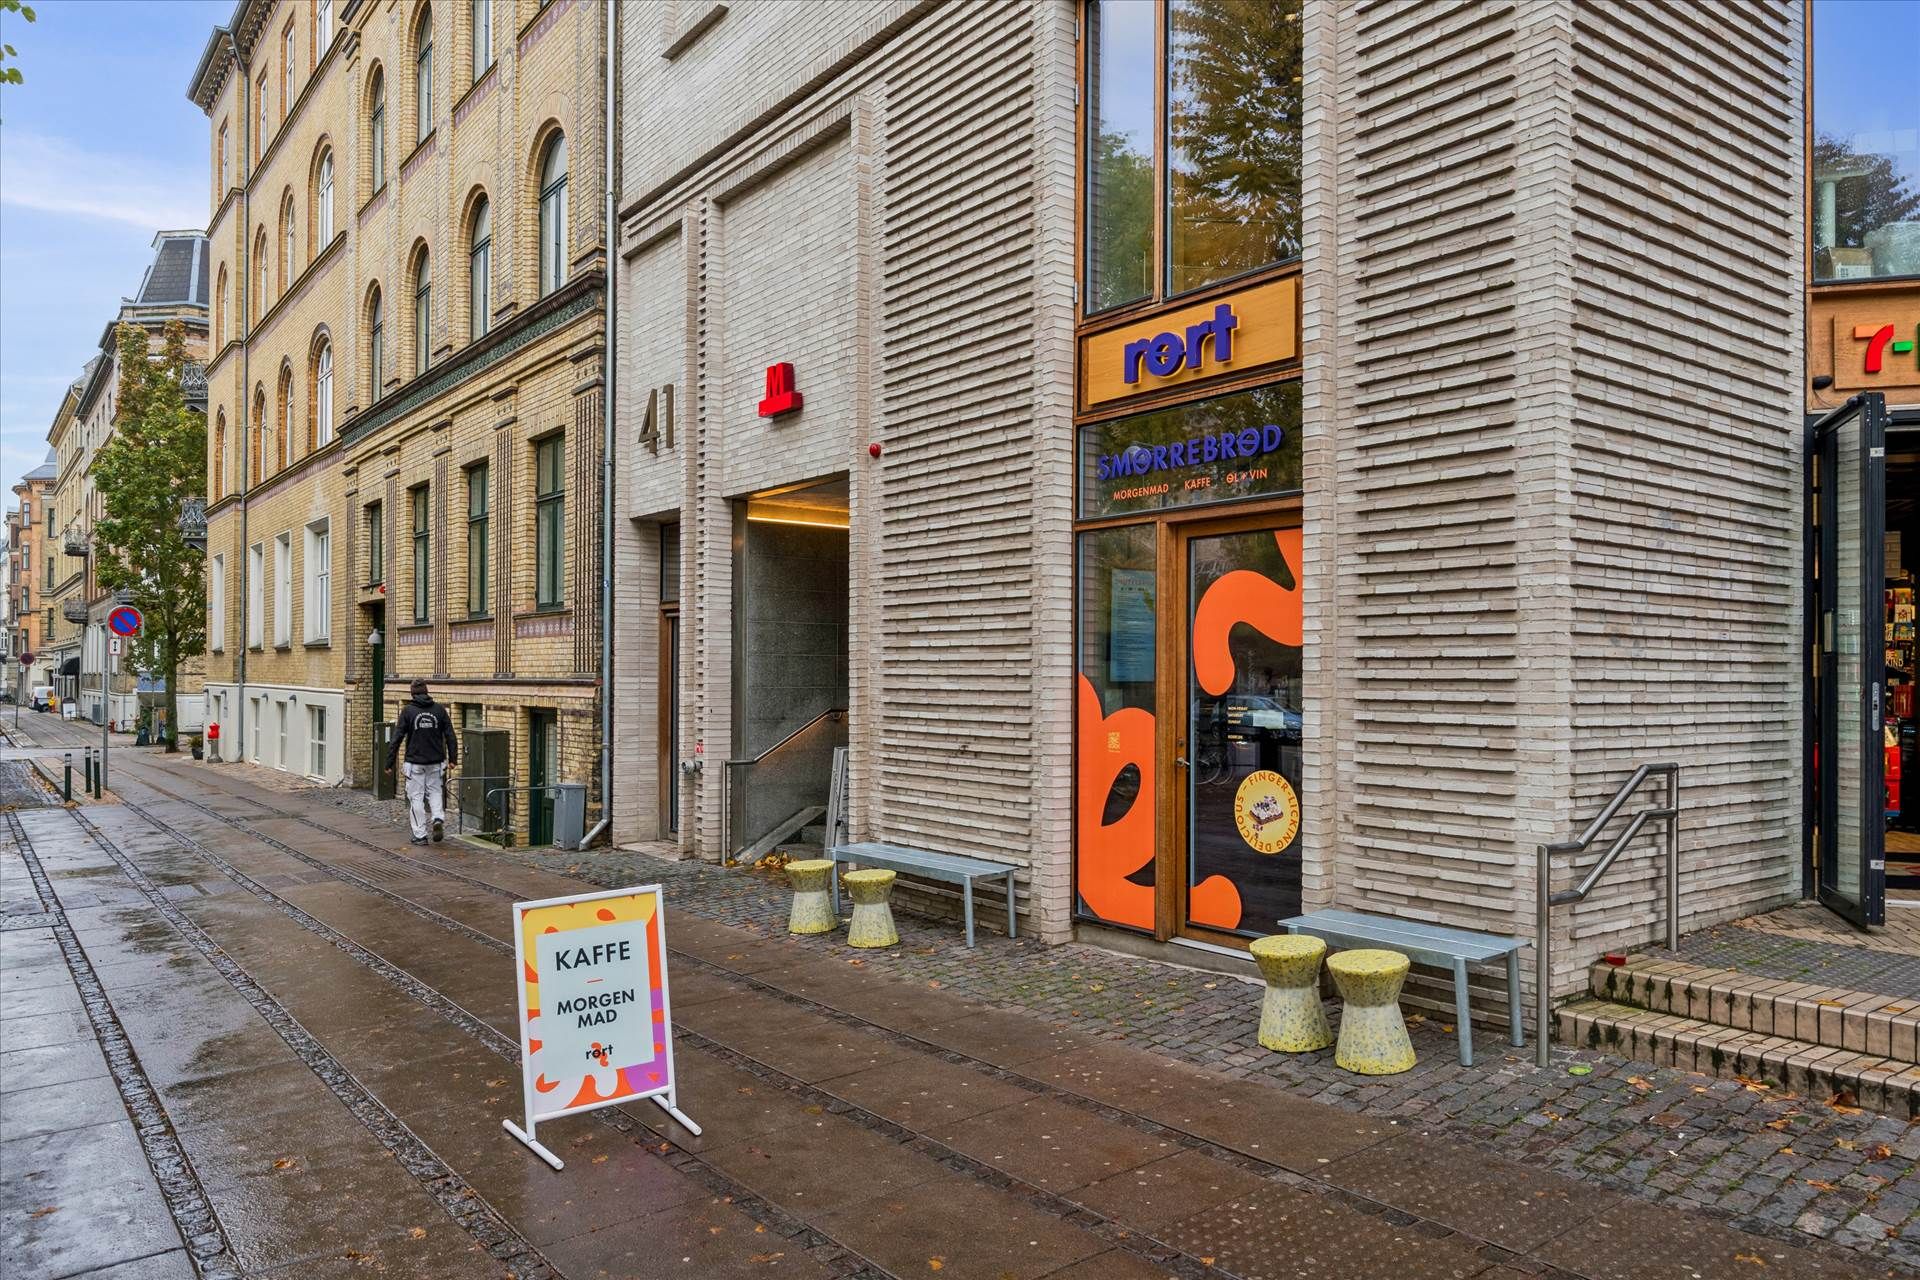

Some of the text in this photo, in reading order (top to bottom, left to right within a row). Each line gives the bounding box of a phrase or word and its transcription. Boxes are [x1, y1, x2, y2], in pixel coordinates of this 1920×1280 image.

[638, 384, 675, 454] 41
[1097, 424, 1283, 480] SMØRREBRØD
[1113, 484, 1169, 501] MORGENMAD
[1184, 477, 1211, 491] KAFFE
[1249, 468, 1268, 480] VIN
[1236, 795, 1272, 852] DELICIOUS
[556, 940, 631, 971] KAFFE
[557, 988, 635, 1015] MORGEN
[577, 1009, 618, 1029] MAD
